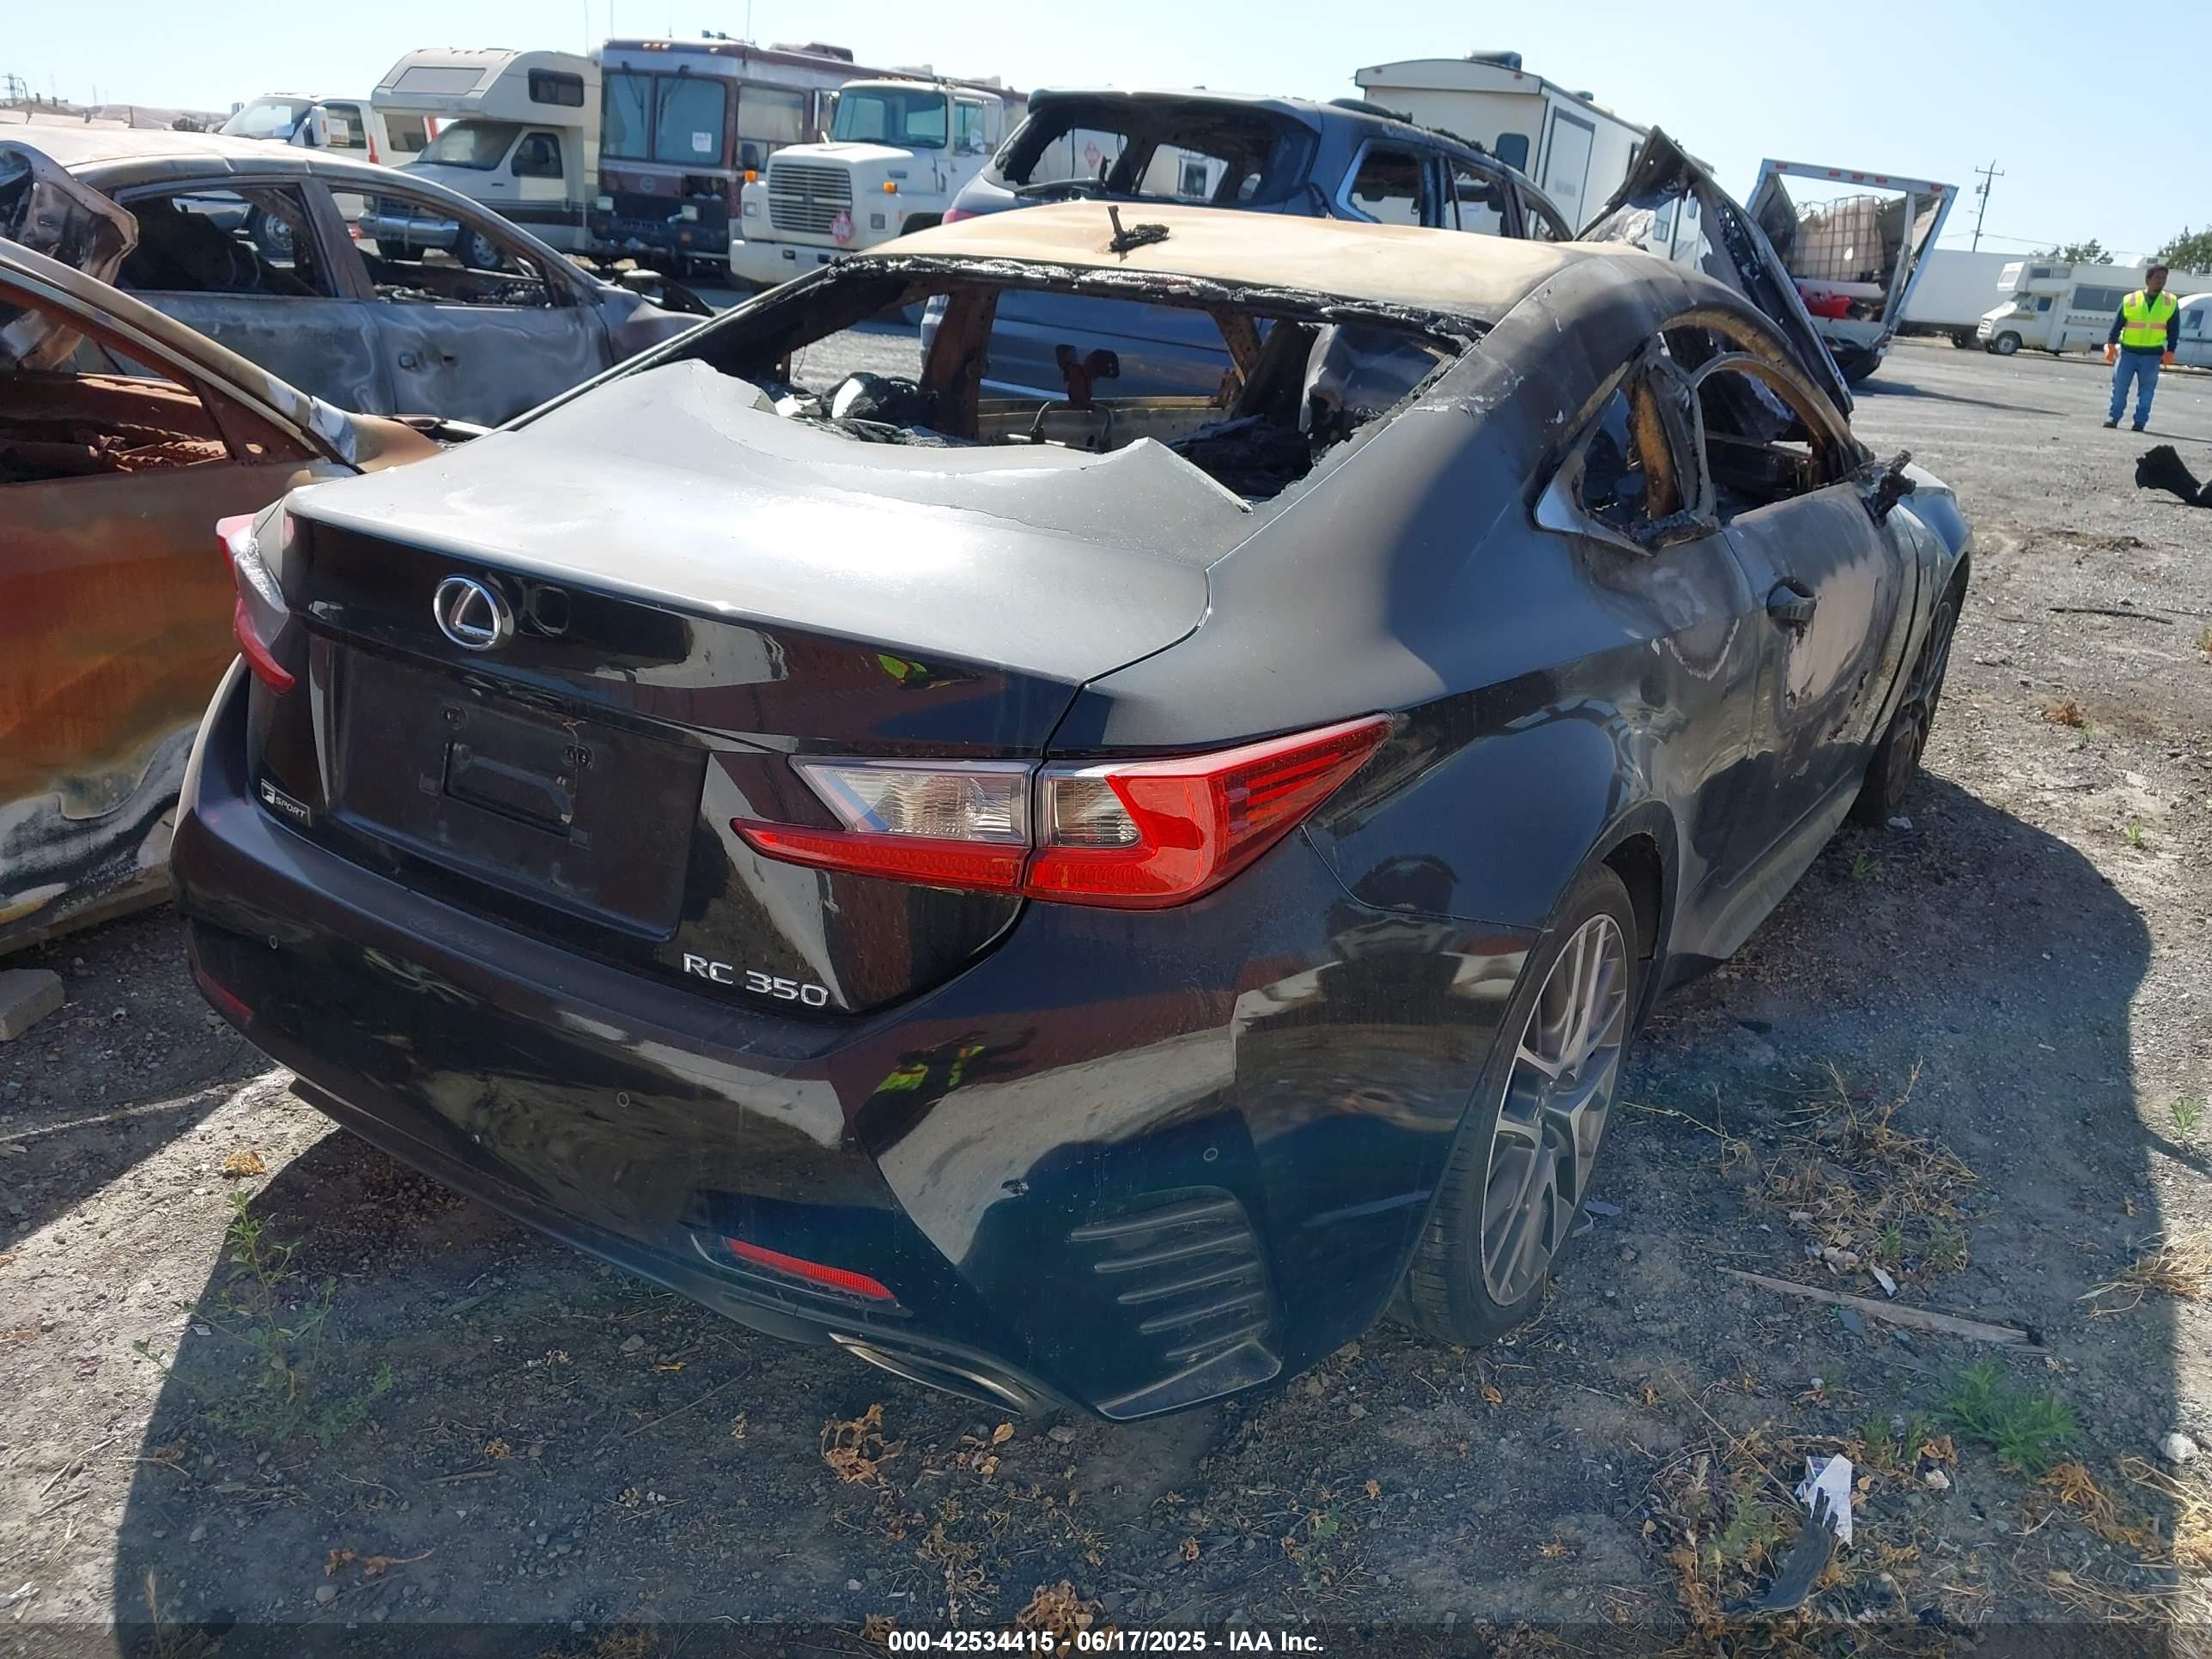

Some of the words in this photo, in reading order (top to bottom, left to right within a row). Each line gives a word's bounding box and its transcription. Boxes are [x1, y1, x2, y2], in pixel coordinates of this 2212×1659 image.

[275, 796, 307, 818] SPORT
[683, 952, 734, 985] RC
[745, 969, 830, 1006] 350
